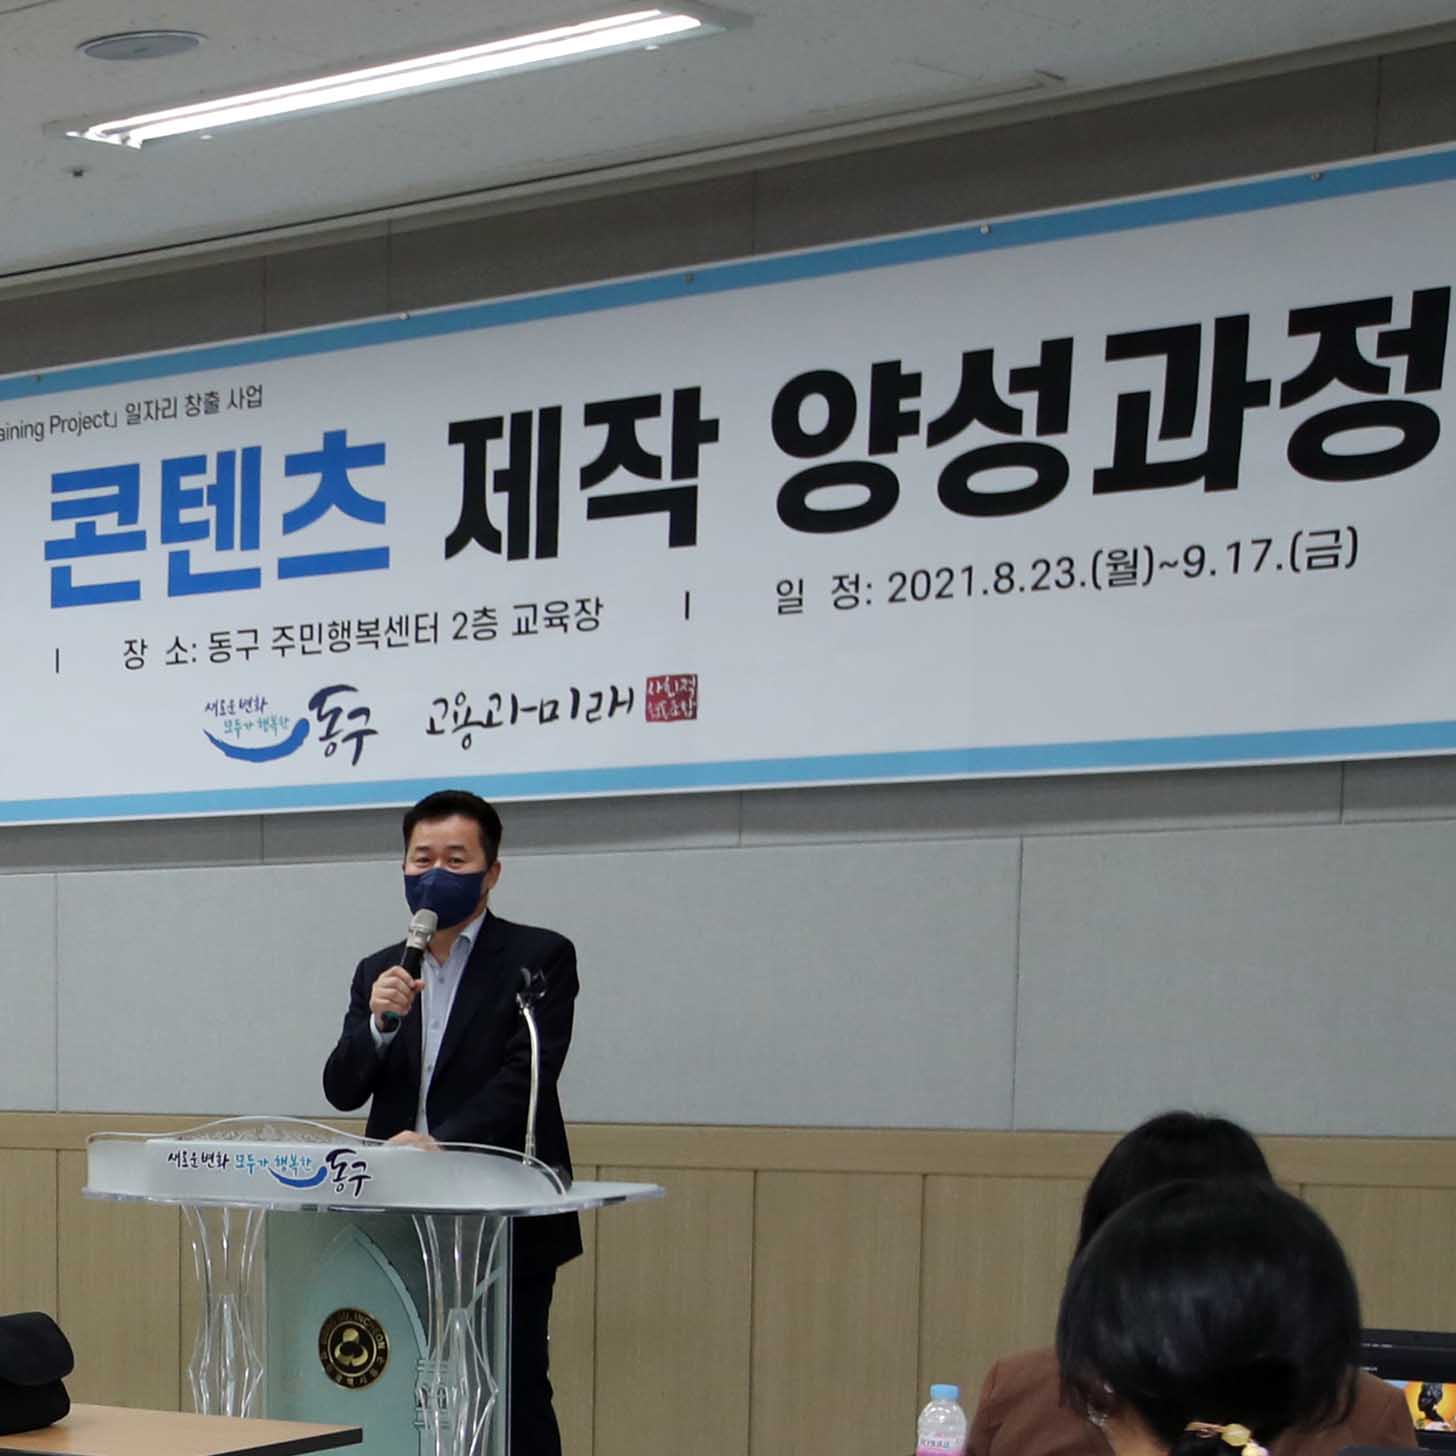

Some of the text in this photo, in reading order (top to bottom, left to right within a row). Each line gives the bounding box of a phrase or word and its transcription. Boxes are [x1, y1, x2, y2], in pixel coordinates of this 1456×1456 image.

[125, 396, 178, 426] 일자리
[184, 391, 221, 418] 창출
[227, 384, 264, 410] 사업
[44, 428, 390, 609] 콘텐츠
[445, 385, 720, 562] 제작
[770, 285, 1452, 534] 양성과정
[775, 577, 806, 616] 일
[830, 572, 874, 613] 정:
[123, 595, 605, 672] 장 소: 동구 주민행복센터 2층 교육장
[308, 684, 379, 766] 동구
[235, 1152, 268, 1175] 모두가
[273, 1152, 313, 1176] 행복한
[325, 1148, 372, 1197] 동구
